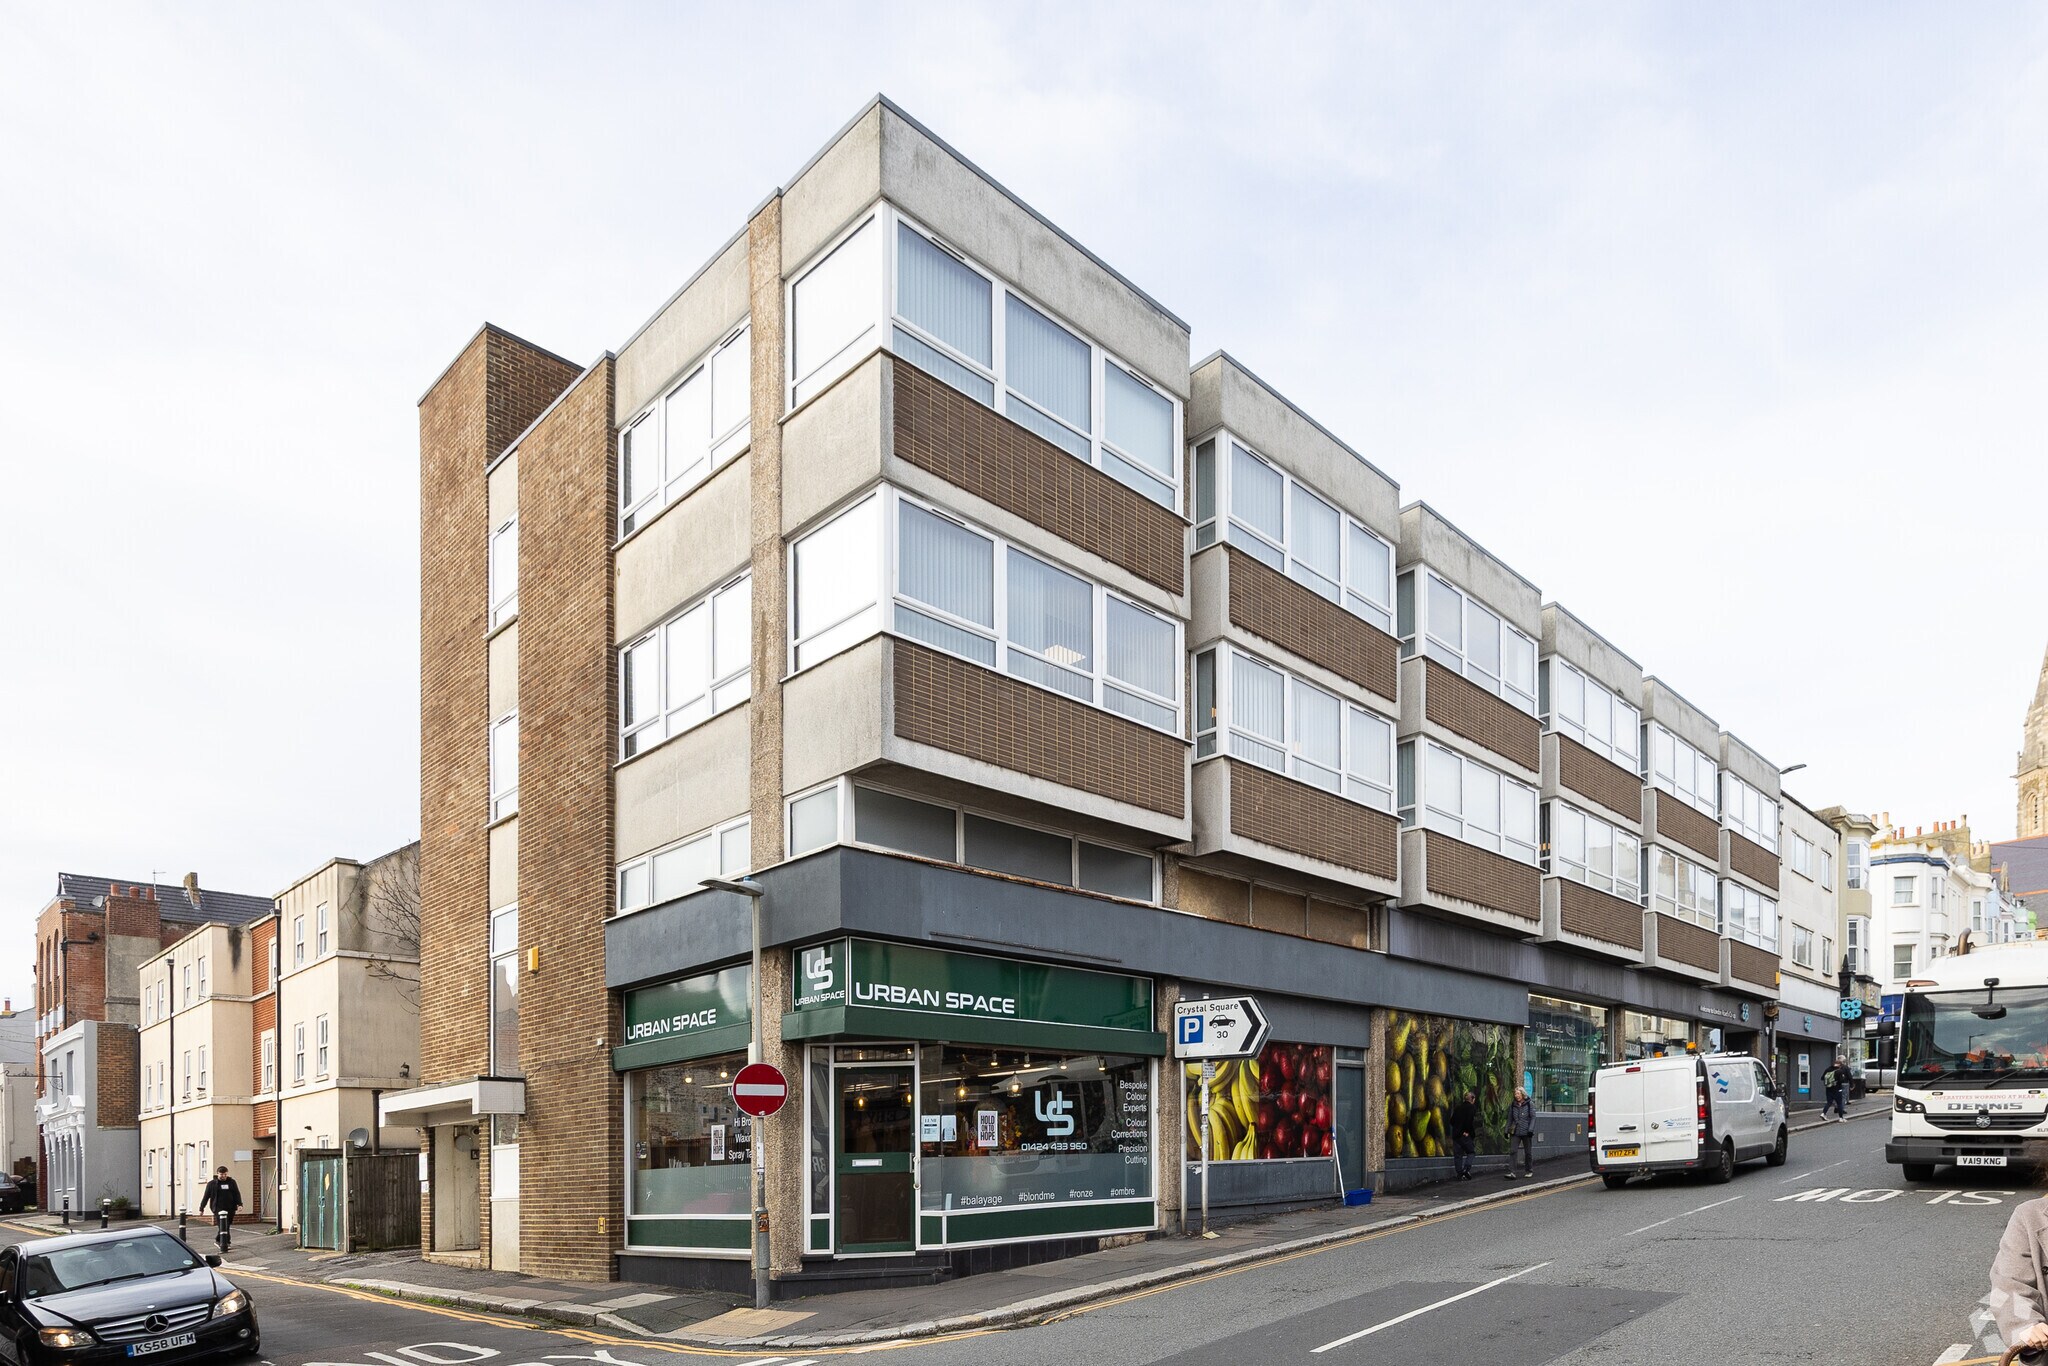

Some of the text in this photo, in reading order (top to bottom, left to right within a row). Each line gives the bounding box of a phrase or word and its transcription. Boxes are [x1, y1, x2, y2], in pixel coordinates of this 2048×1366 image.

[794, 990, 845, 1006] URBAN SPACE
[855, 982, 1015, 1014] URBAN SPACE
[1177, 1003, 1239, 1015] Crystal Square
[627, 1008, 717, 1040] URBAN SPACE
[1184, 1018, 1200, 1042] P
[1216, 1030, 1229, 1039] 30
[1119, 1080, 1148, 1091] Bespoke
[1125, 1091, 1147, 1101] Colour
[1123, 1103, 1147, 1113] Experts
[1947, 1102, 2023, 1111] DENNIS
[741, 1117, 752, 1127] Bro
[980, 1115, 995, 1125] HOLD
[1125, 1118, 1147, 1127] Colour
[980, 1131, 996, 1141] HOPE
[1110, 1130, 1148, 1139] Corrections
[1021, 1142, 1088, 1152] 01424 433 960
[1118, 1144, 1148, 1153] Precision
[728, 1149, 745, 1161] Spray
[1124, 1155, 1148, 1166] Cutting
[1962, 1157, 2001, 1165] VA19 KNG
[960, 1187, 1136, 1207] #balayage #blondme #ronze #ombre
[1773, 1187, 2016, 1206] SLOW
[135, 1333, 195, 1354] KS58 UFM
